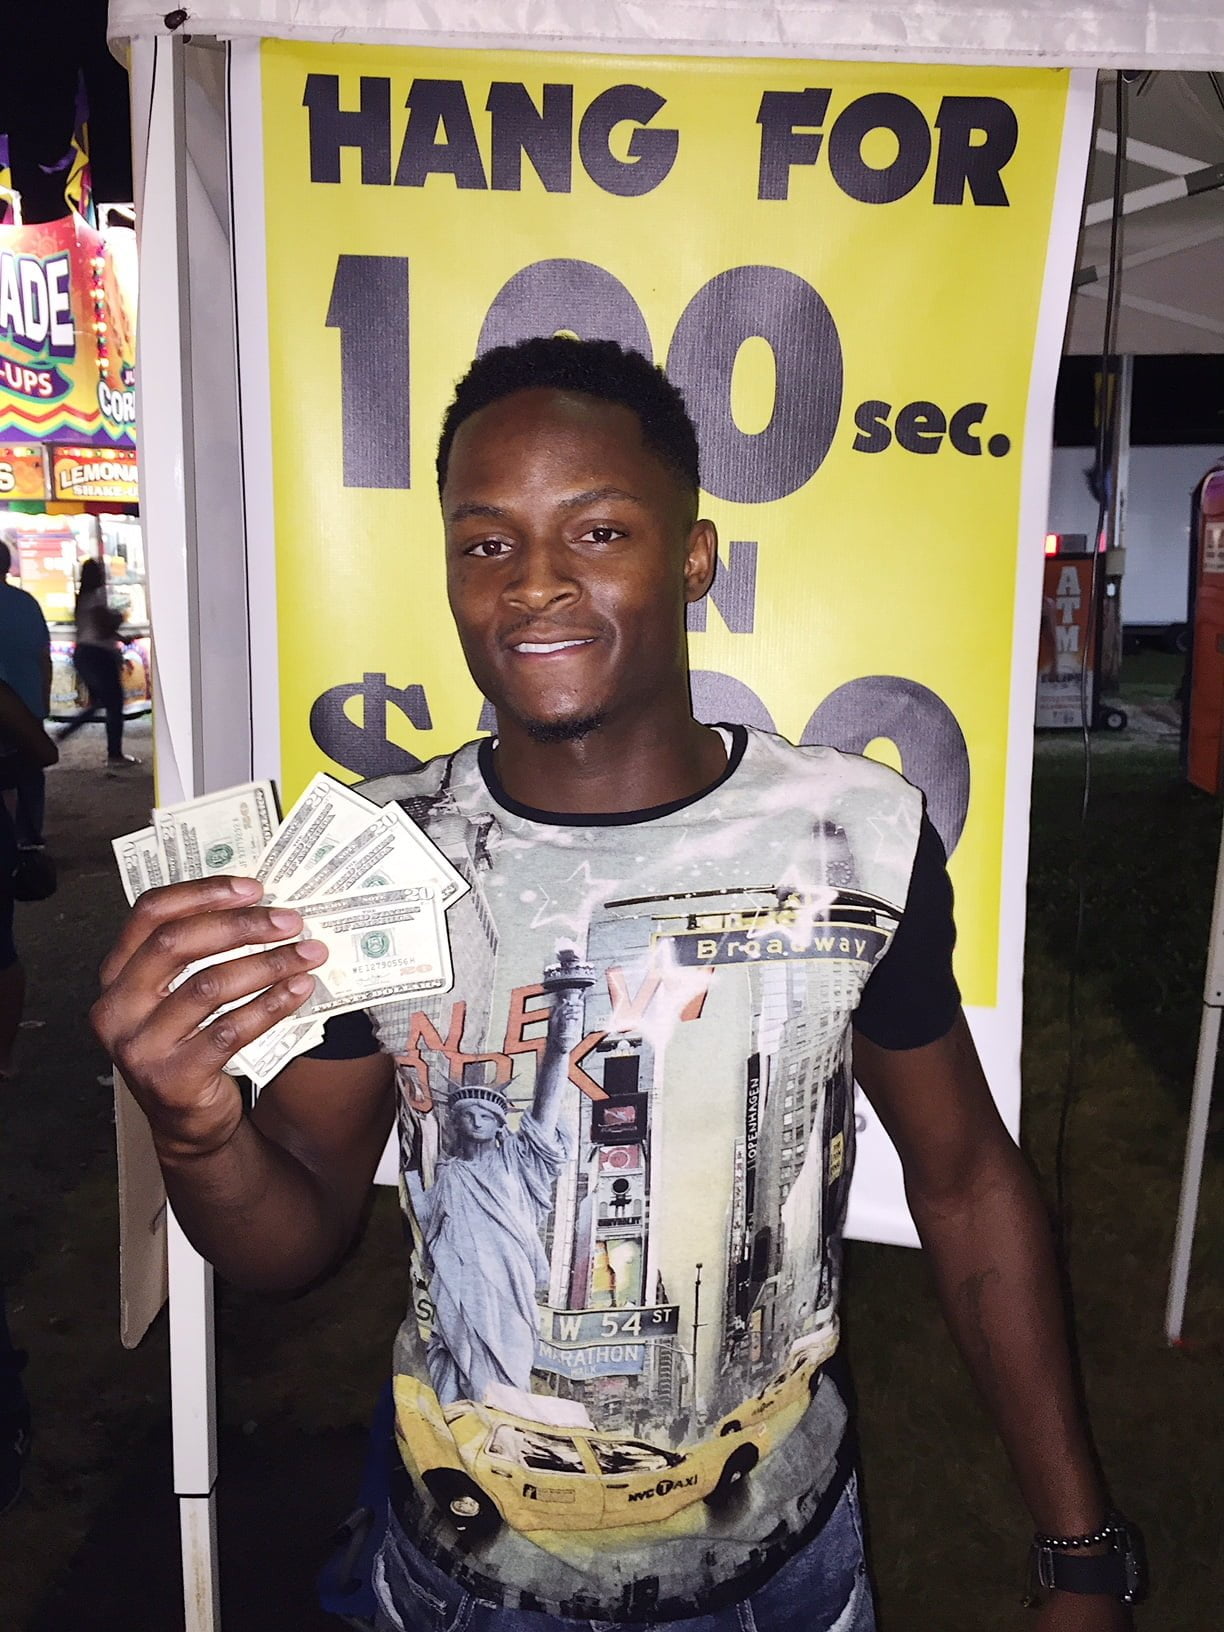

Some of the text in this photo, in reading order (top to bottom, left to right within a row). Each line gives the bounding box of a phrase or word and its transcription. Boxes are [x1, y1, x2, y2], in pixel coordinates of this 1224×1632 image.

[302, 73, 1019, 206] HANG FOR
[325, 254, 1011, 504] 10 sec.
[686, 541, 758, 634] N
[1055, 565, 1081, 652] ATM
[309, 672, 971, 860] $0
[403, 886, 434, 901] 20
[560, 1308, 673, 1341] W 54 ST
